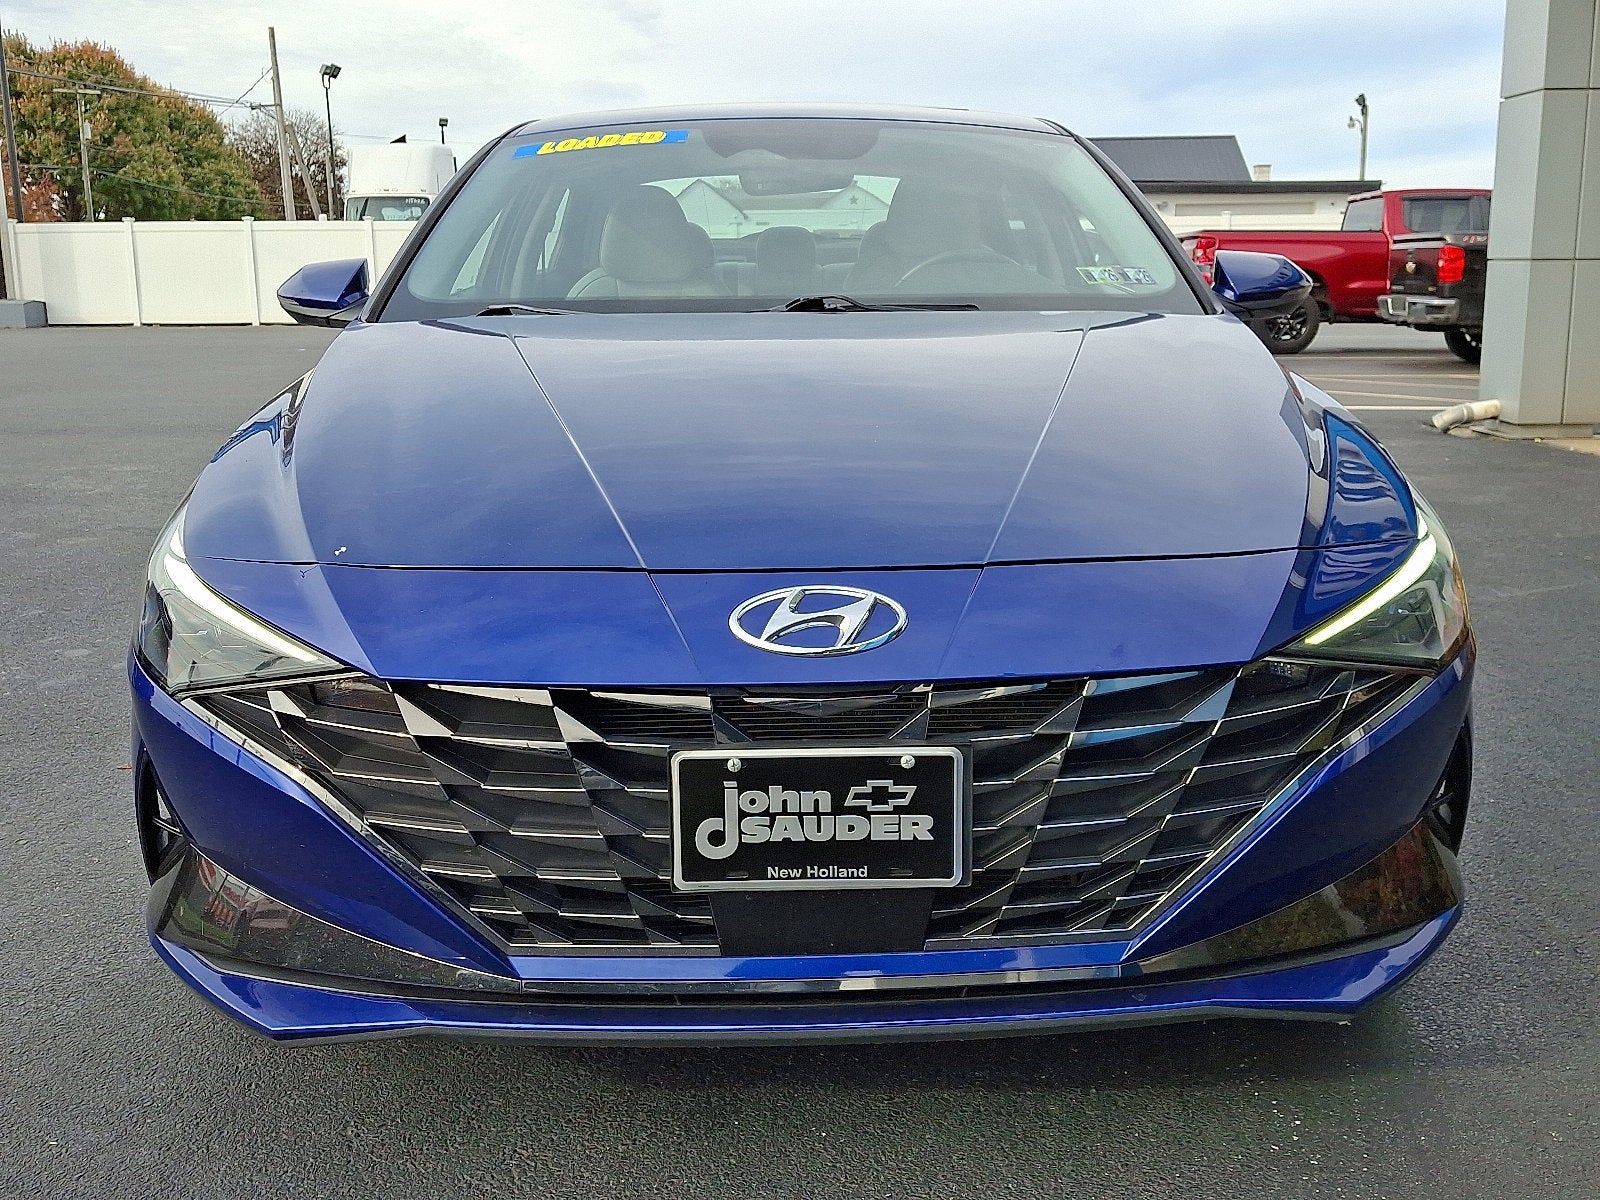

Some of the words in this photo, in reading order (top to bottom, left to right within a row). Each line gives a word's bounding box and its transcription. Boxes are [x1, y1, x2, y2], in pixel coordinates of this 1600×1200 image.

[537, 131, 666, 155] LOADED
[695, 781, 831, 860] john
[740, 814, 934, 844] SAUDER
[767, 866, 802, 879] New
[806, 865, 868, 878] Holland
